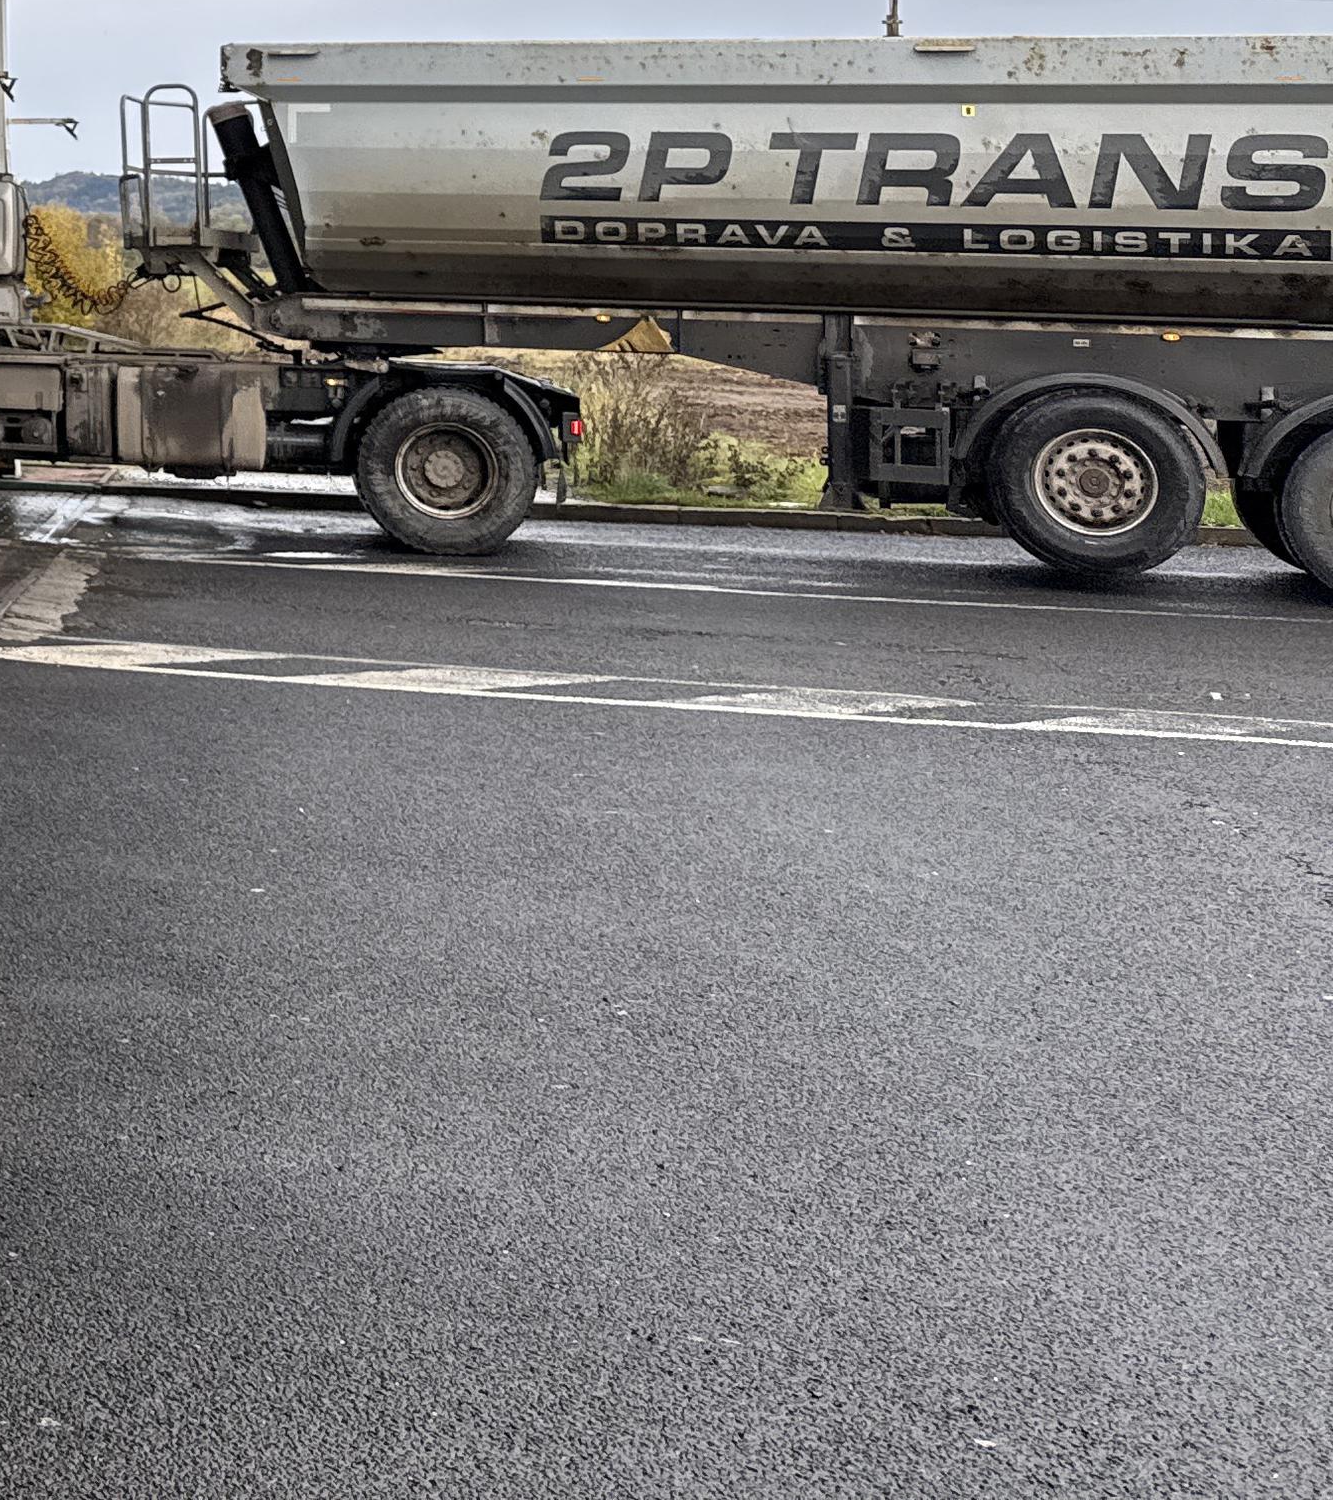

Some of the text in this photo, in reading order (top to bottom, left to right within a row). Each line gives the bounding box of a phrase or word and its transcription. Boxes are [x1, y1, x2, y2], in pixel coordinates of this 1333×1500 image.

[539, 131, 1329, 212] 2P TRANS
[554, 220, 1314, 257] DOPRAVA & LOGISTIKA
